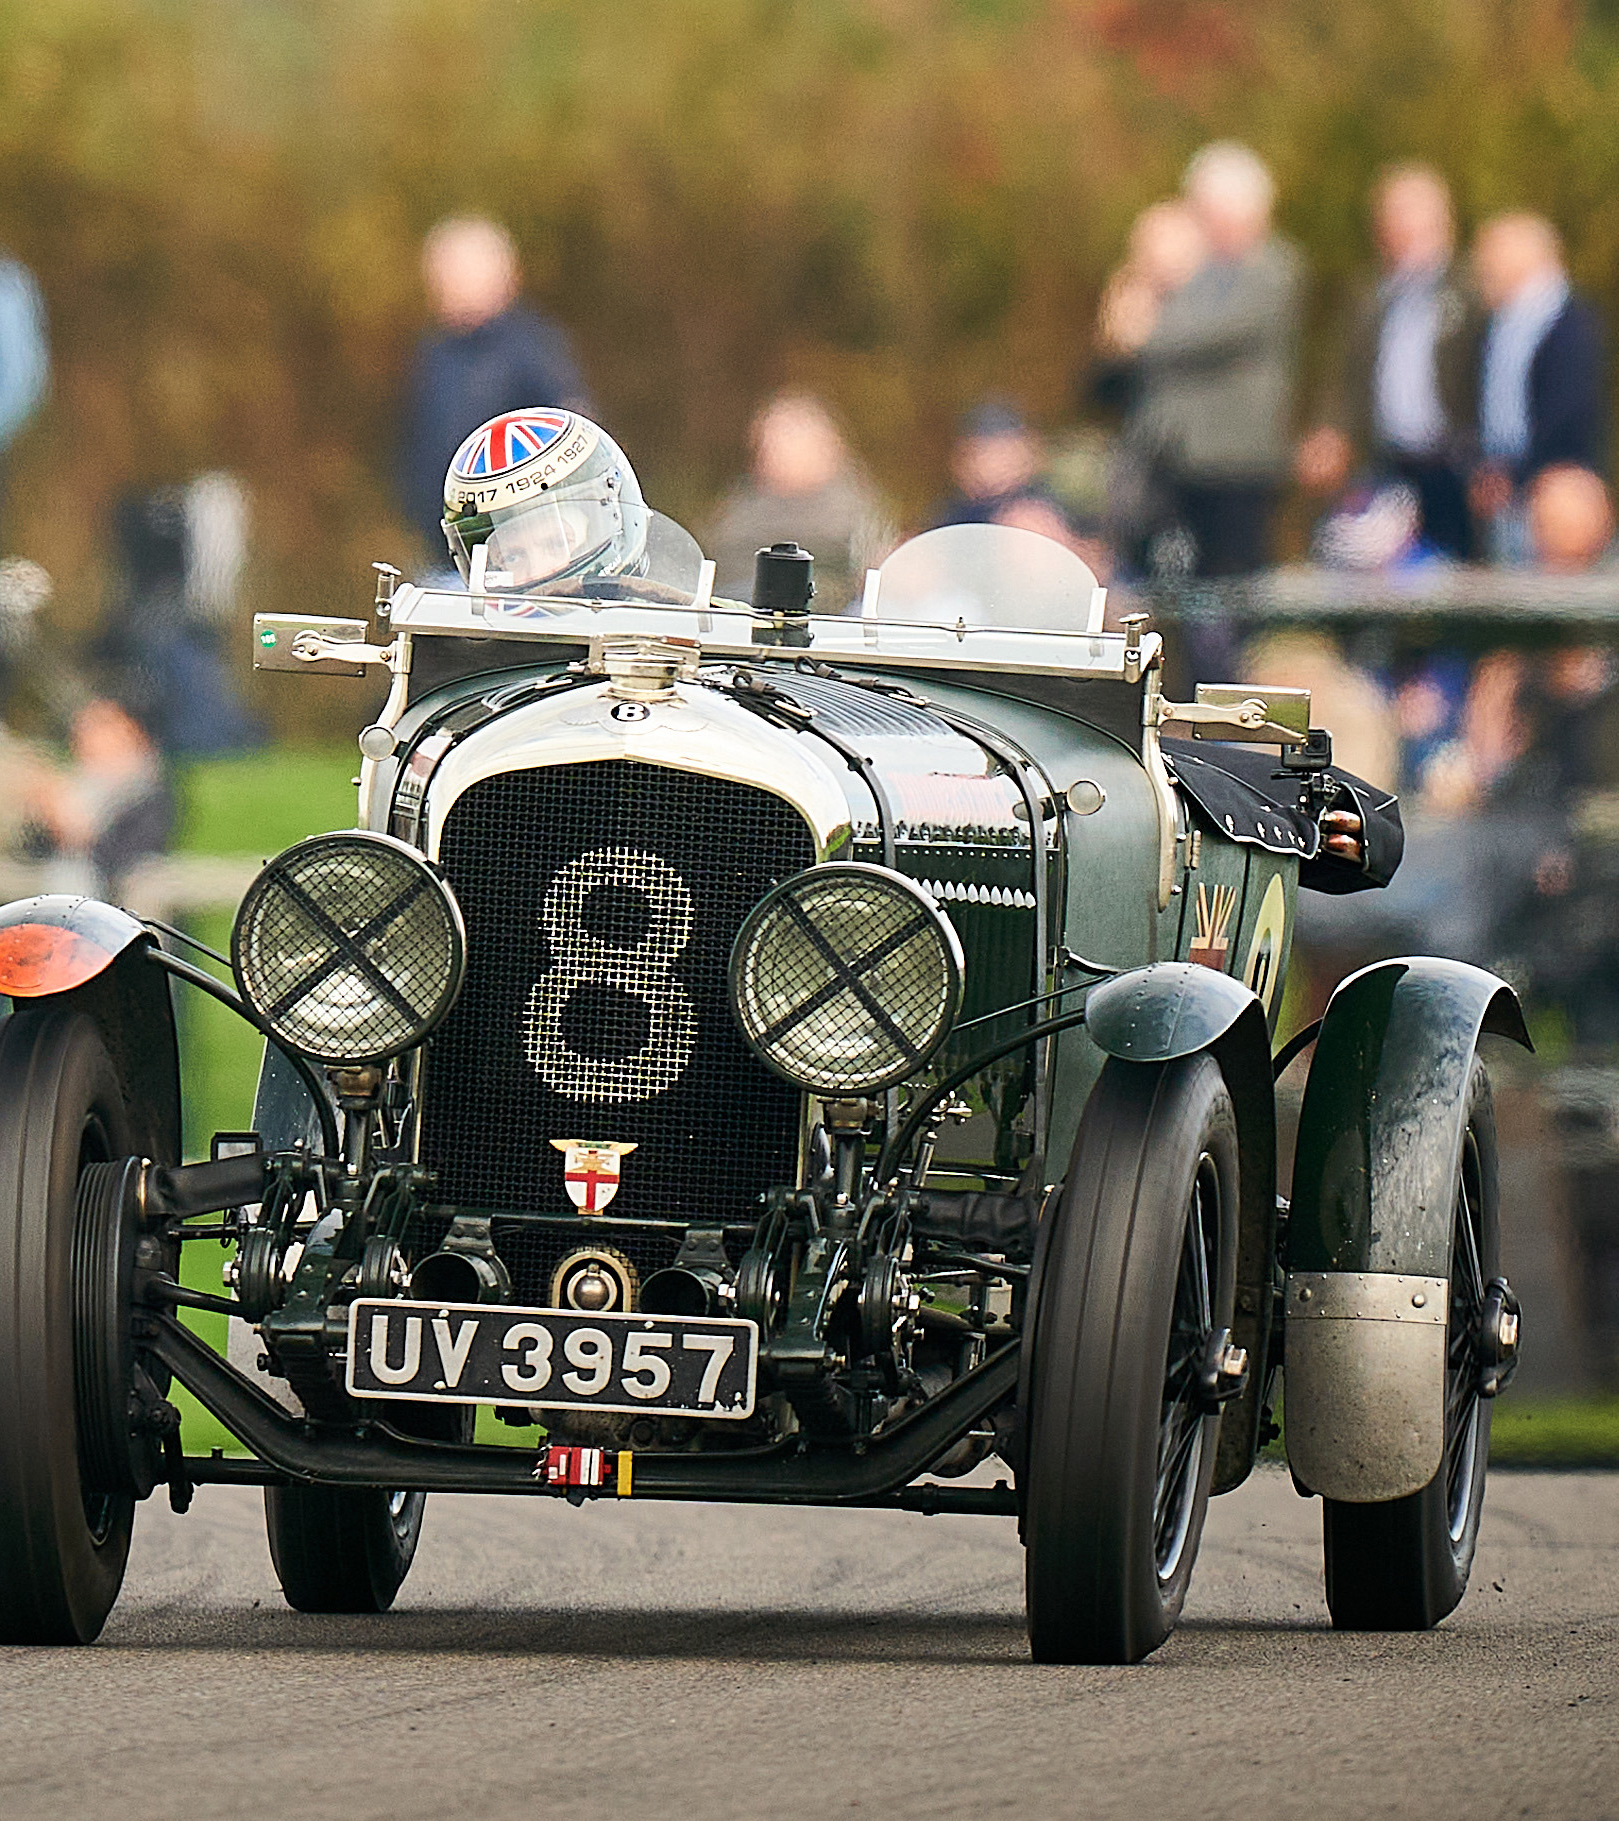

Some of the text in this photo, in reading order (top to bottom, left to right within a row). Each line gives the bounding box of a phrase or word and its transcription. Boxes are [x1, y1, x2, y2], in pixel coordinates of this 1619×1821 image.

[458, 488, 497, 504] 2017
[505, 464, 556, 494] 1924
[557, 434, 588, 465] 1927
[616, 702, 646, 721] B
[521, 846, 698, 1103] 8
[369, 1314, 735, 1403] UV 3957
